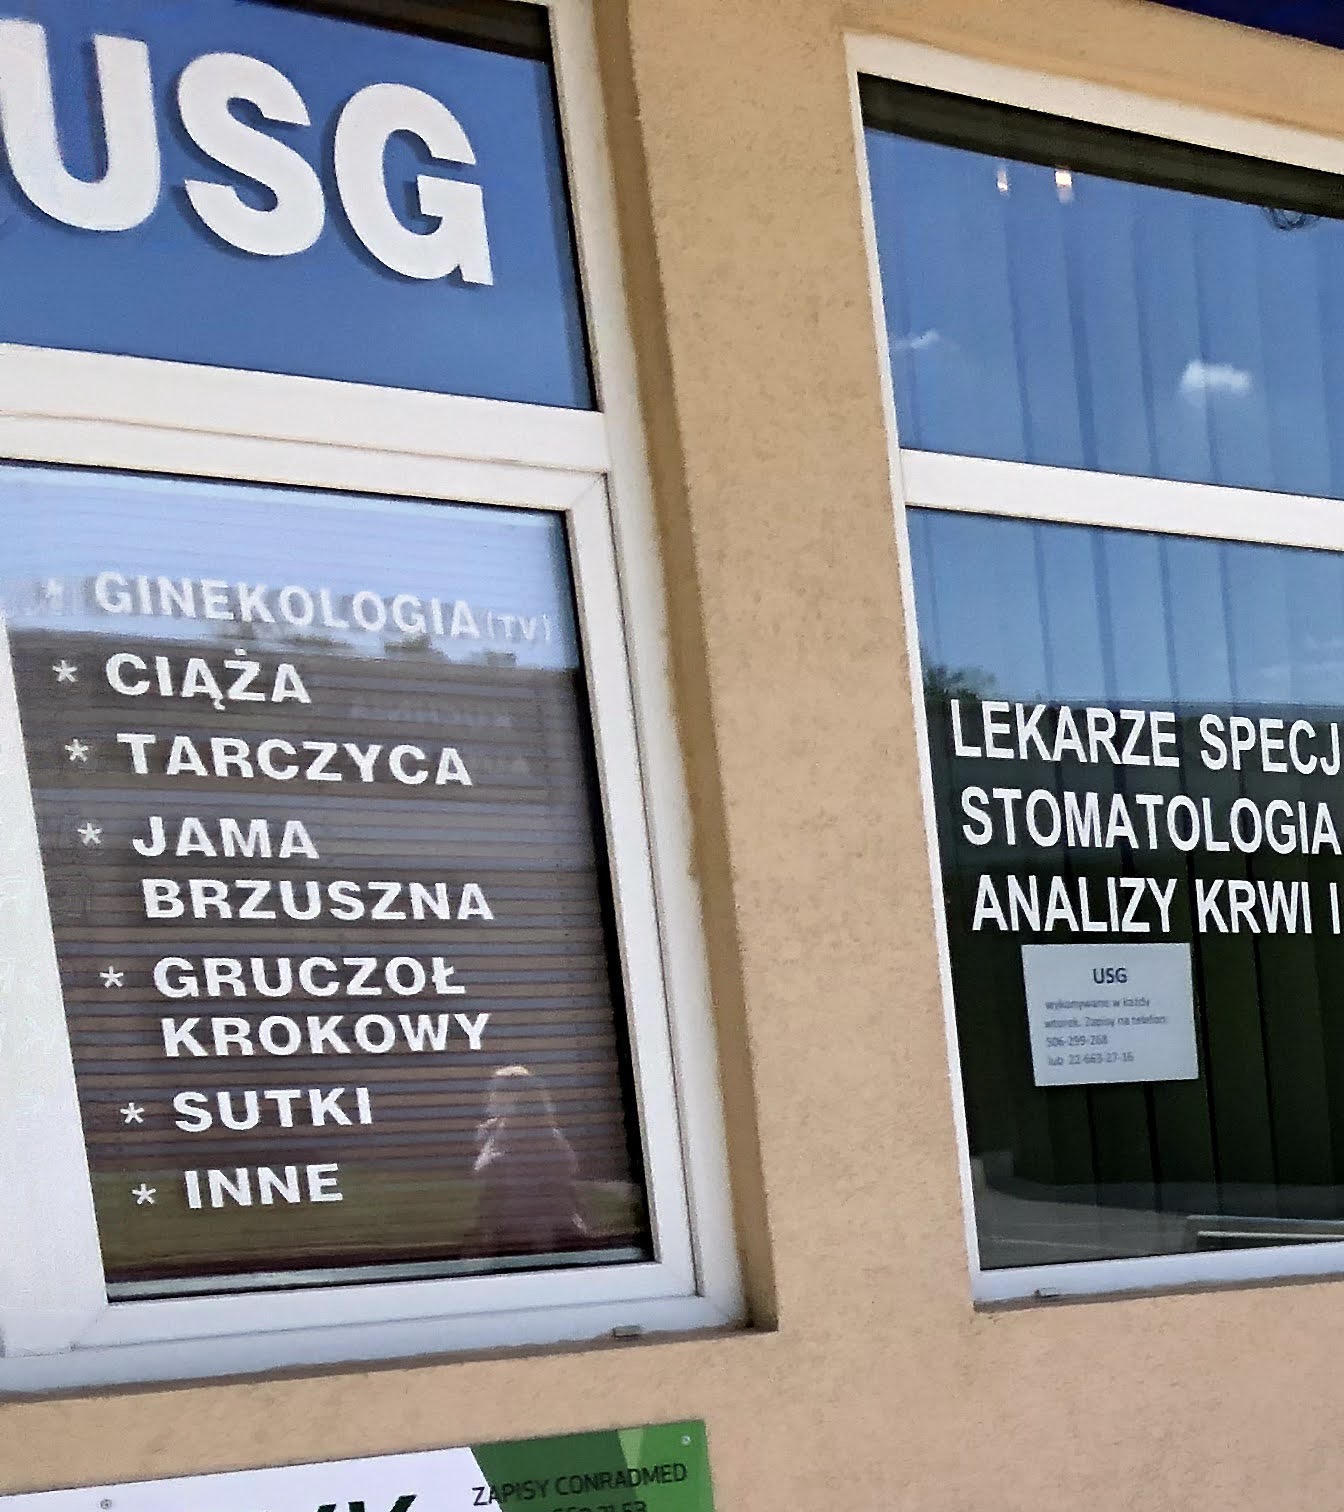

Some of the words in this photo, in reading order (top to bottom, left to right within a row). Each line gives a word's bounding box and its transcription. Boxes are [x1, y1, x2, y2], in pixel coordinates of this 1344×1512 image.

[0, 17, 495, 287] USG
[94, 570, 481, 641] GINEKOLOGIA
[106, 647, 312, 711] CIĄŻA
[950, 697, 1180, 768] LEKARZE
[116, 732, 474, 787] TARCZYCA
[132, 815, 320, 859] JAMA
[961, 785, 1342, 856] STOMATOLOGIA
[141, 877, 495, 921] BRZUSZNA
[972, 874, 1178, 934] ANALIZY
[1196, 878, 1314, 935] KRWI
[1329, 881, 1341, 935] I
[153, 955, 467, 998] GRUCZOŁ
[1092, 967, 1128, 985] USG
[161, 1012, 492, 1058] KROKOWY
[175, 1086, 374, 1133] SUTKI
[183, 1162, 345, 1210] INNE
[471, 1479, 550, 1507] ZAPISY
[555, 1462, 688, 1496] CONRADMED
